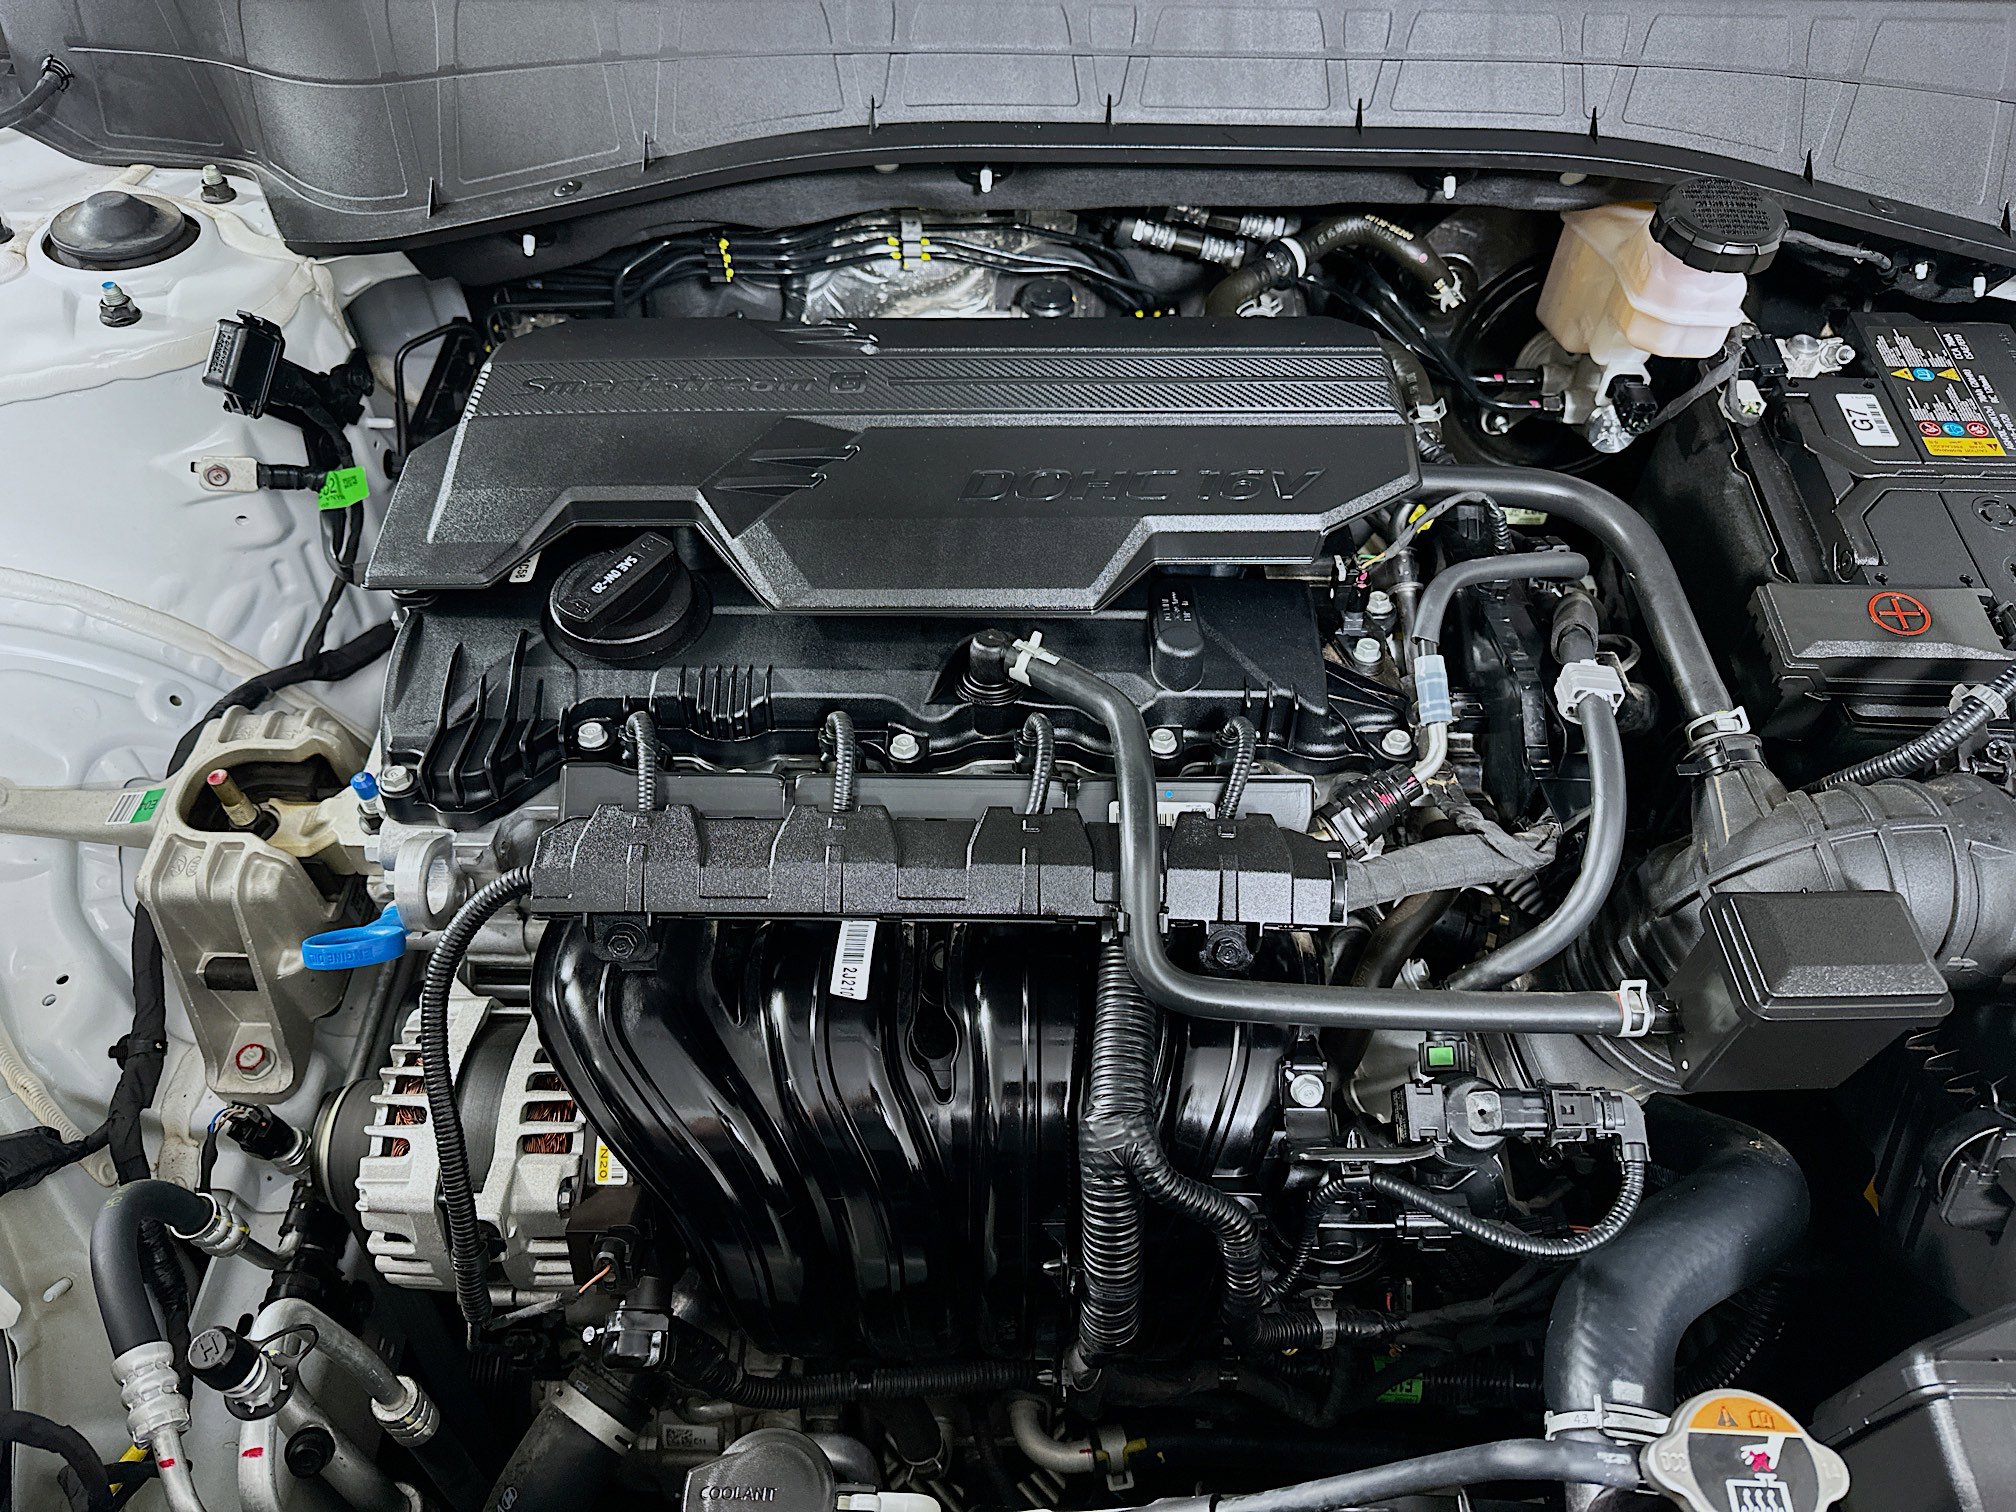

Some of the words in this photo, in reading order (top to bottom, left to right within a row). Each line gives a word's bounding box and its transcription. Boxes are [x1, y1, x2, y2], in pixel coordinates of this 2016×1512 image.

[1951, 348, 1964, 360] CCA
[1845, 408, 1874, 431] G7
[958, 469, 1178, 501] DOHC
[1198, 469, 1326, 501] 16V
[617, 555, 638, 573] SAE
[591, 569, 622, 594] 0W-20
[599, 1148, 609, 1179] N20
[1573, 1413, 1589, 1425] 43
[699, 1485, 779, 1502] COOLANT
